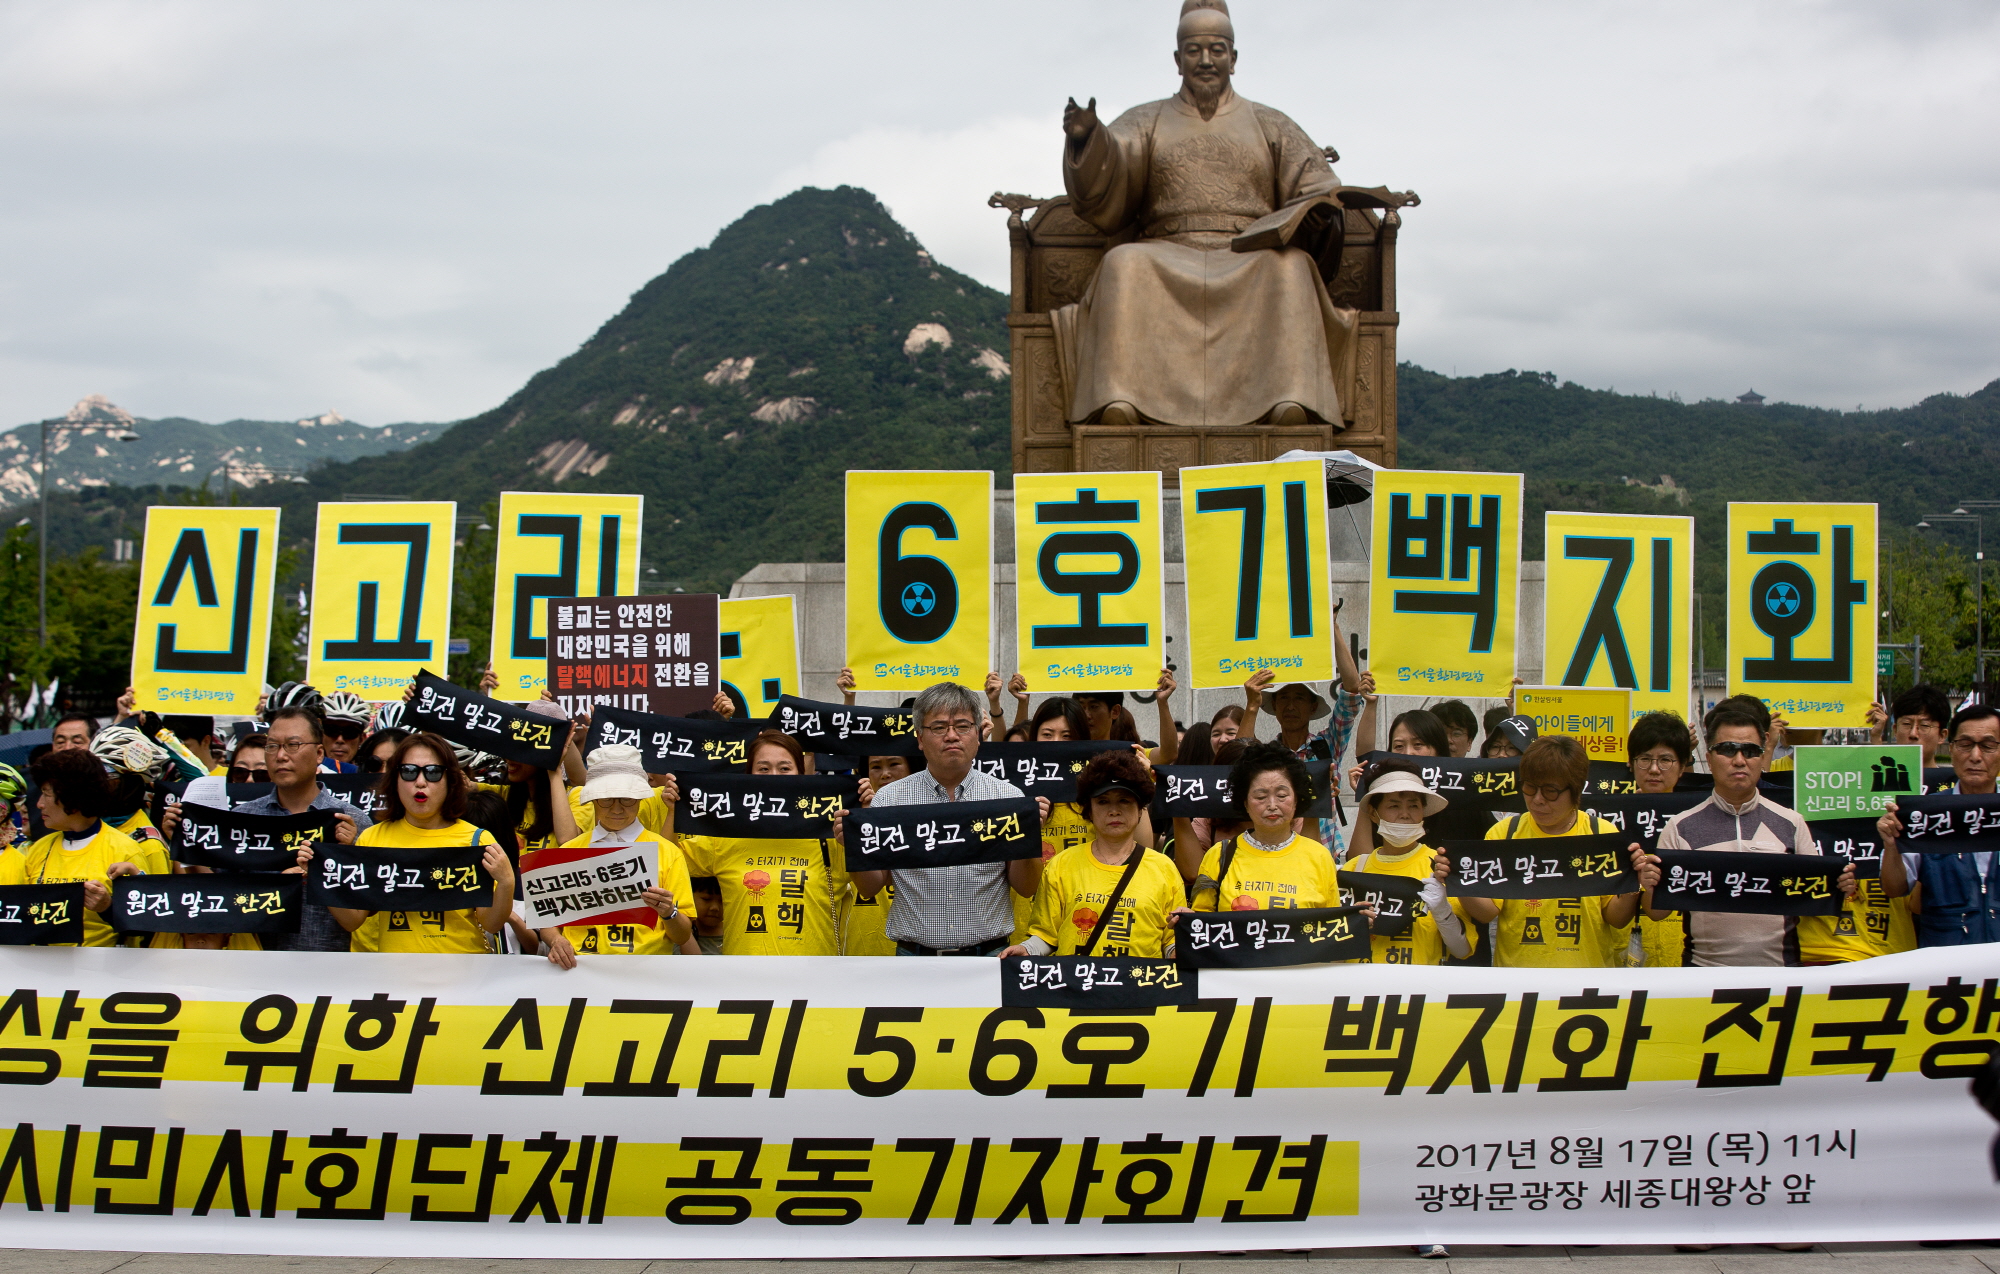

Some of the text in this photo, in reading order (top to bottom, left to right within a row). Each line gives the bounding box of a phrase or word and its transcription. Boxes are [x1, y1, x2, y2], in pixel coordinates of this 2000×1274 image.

[878, 501, 960, 644] 6
[1031, 488, 1149, 649] 호
[1196, 480, 1314, 642] 기
[1387, 492, 1501, 653] 백
[152, 528, 260, 673] 신
[323, 522, 434, 661] 고
[510, 513, 622, 659] 리
[1743, 518, 1867, 683] 화
[557, 603, 673, 630] 불교는 안전한
[1561, 535, 1673, 692] 지
[557, 632, 691, 660] 대한민국을 위해
[557, 662, 710, 689] 탈핵에너지 전환을
[889, 664, 960, 678] 서울환경연합
[1063, 663, 1133, 679] 서울환경연합
[1233, 655, 1304, 672] 서울환경연합
[1412, 667, 1485, 683] 서울환경연합
[170, 687, 235, 702] 서울환경연합
[1770, 699, 1845, 714] 서울환경연합
[417, 686, 552, 751] 원전 말고 안전
[780, 706, 825, 737] 원전
[832, 711, 877, 740] 말고
[1535, 715, 1615, 732] 아이들에게
[652, 731, 695, 759] 말고
[701, 738, 748, 765] 안전
[1017, 757, 1064, 787] 말고
[1165, 774, 1208, 803] 원전
[1421, 766, 1518, 797] 말고 안전
[1805, 771, 1862, 789] STOP!
[689, 787, 843, 823] 원전 말고 안전
[1805, 795, 1850, 812] 신고리
[182, 818, 222, 850] 원전
[230, 828, 274, 854] 말고
[860, 812, 1025, 855] 원전 말고 안전
[1070, 824, 1088, 833] 전에
[1907, 810, 1955, 838] 원전
[322, 858, 481, 892] 원전 말고 안전
[757, 857, 786, 866] 터지기
[790, 857, 809, 866] 전에
[1459, 851, 1622, 886] 원전 말고 안전
[1244, 881, 1274, 892] 터지기
[1278, 883, 1297, 894] 전에
[1667, 865, 1831, 899] 원전 말고 안전
[0, 900, 71, 925] 고 안전
[126, 889, 285, 917] 원전 말고 안전
[778, 869, 808, 934] 탈핵
[607, 924, 634, 953] 핵
[1190, 916, 1354, 950] 원전 말고 안전
[1018, 959, 1183, 991] 원전 말고 안전
[224, 993, 440, 1093] 위한
[480, 996, 808, 1099] 신고리
[847, 996, 1272, 1099] 5·6호기
[1323, 987, 1653, 1096] 백지화
[1415, 1128, 1857, 1170] 2017년 8월 17일 (목) 11시
[0, 1122, 1329, 1226] 시민사회단체 공동기자회견
[1414, 1173, 1816, 1214] 광화문광장 세종대왕상 앞
